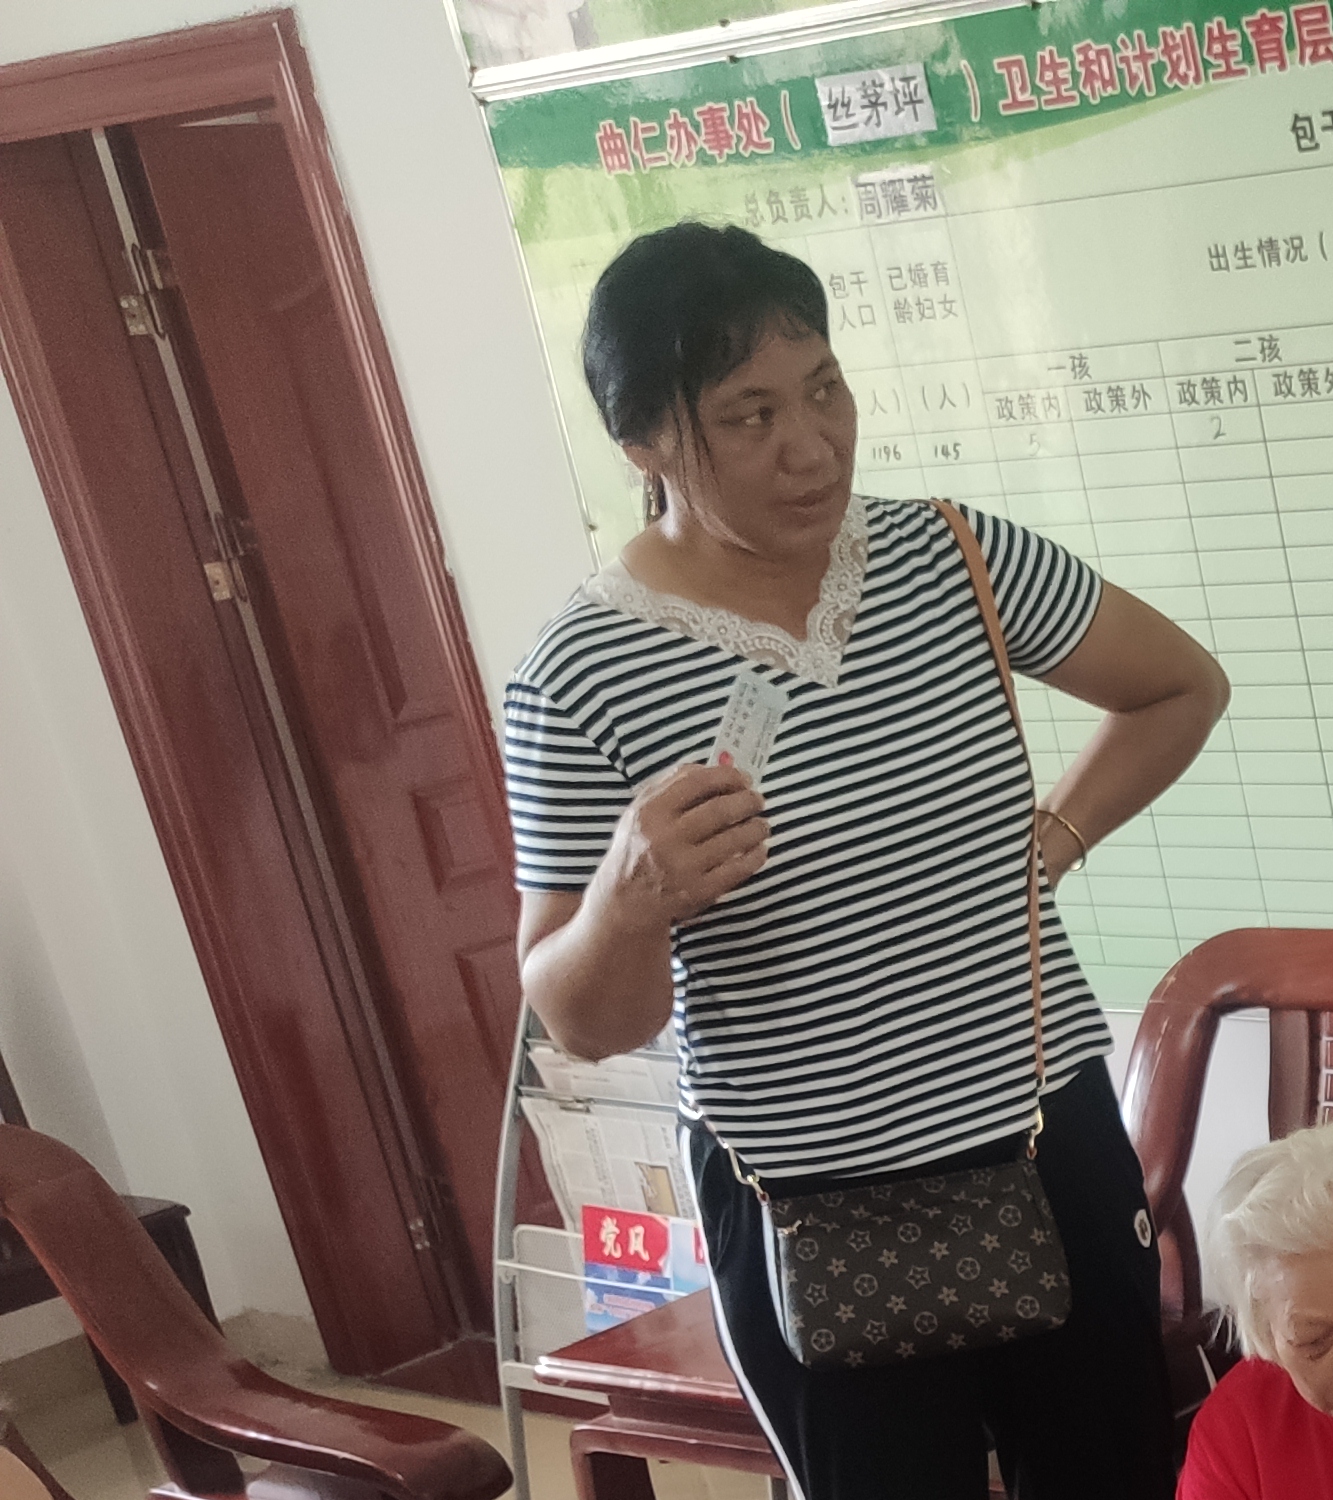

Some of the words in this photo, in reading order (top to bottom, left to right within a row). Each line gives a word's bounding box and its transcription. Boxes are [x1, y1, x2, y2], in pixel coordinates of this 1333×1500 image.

[825, 76, 926, 134] 丝茅坪
[856, 174, 939, 220] 周耀菊
[829, 270, 869, 299] 包干
[887, 261, 951, 292] 已婚育
[838, 304, 877, 332] 人口
[894, 295, 959, 325] 龄妇女
[1233, 336, 1283, 365] 二孩
[1046, 352, 1093, 380] 一孩
[1083, 383, 1152, 415] 政策外
[1177, 374, 1250, 408] 政策内
[995, 392, 1061, 422] 政策内
[1212, 414, 1227, 442] 2
